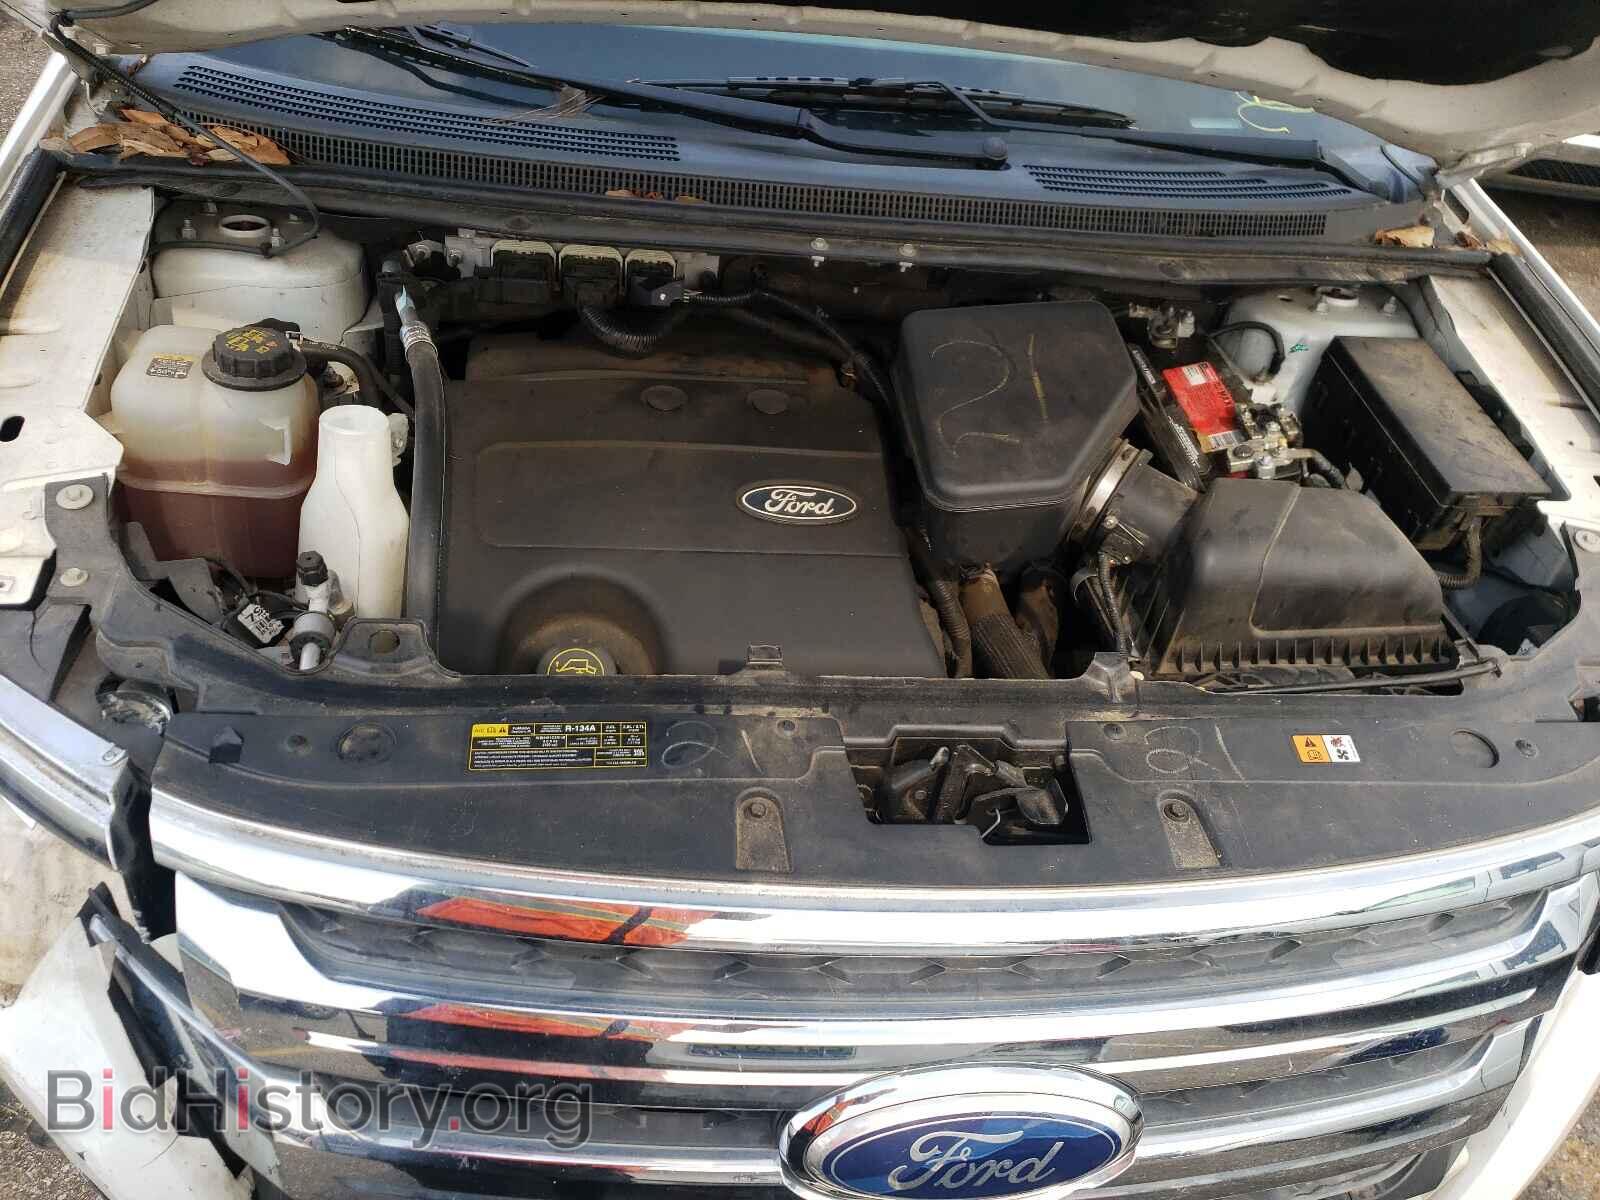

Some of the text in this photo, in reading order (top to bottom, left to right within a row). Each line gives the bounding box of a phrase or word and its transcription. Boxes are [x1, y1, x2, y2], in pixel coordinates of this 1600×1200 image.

[764, 489, 835, 515] Ford
[565, 724, 596, 733] R-134A
[887, 1130, 1064, 1190] Ford
